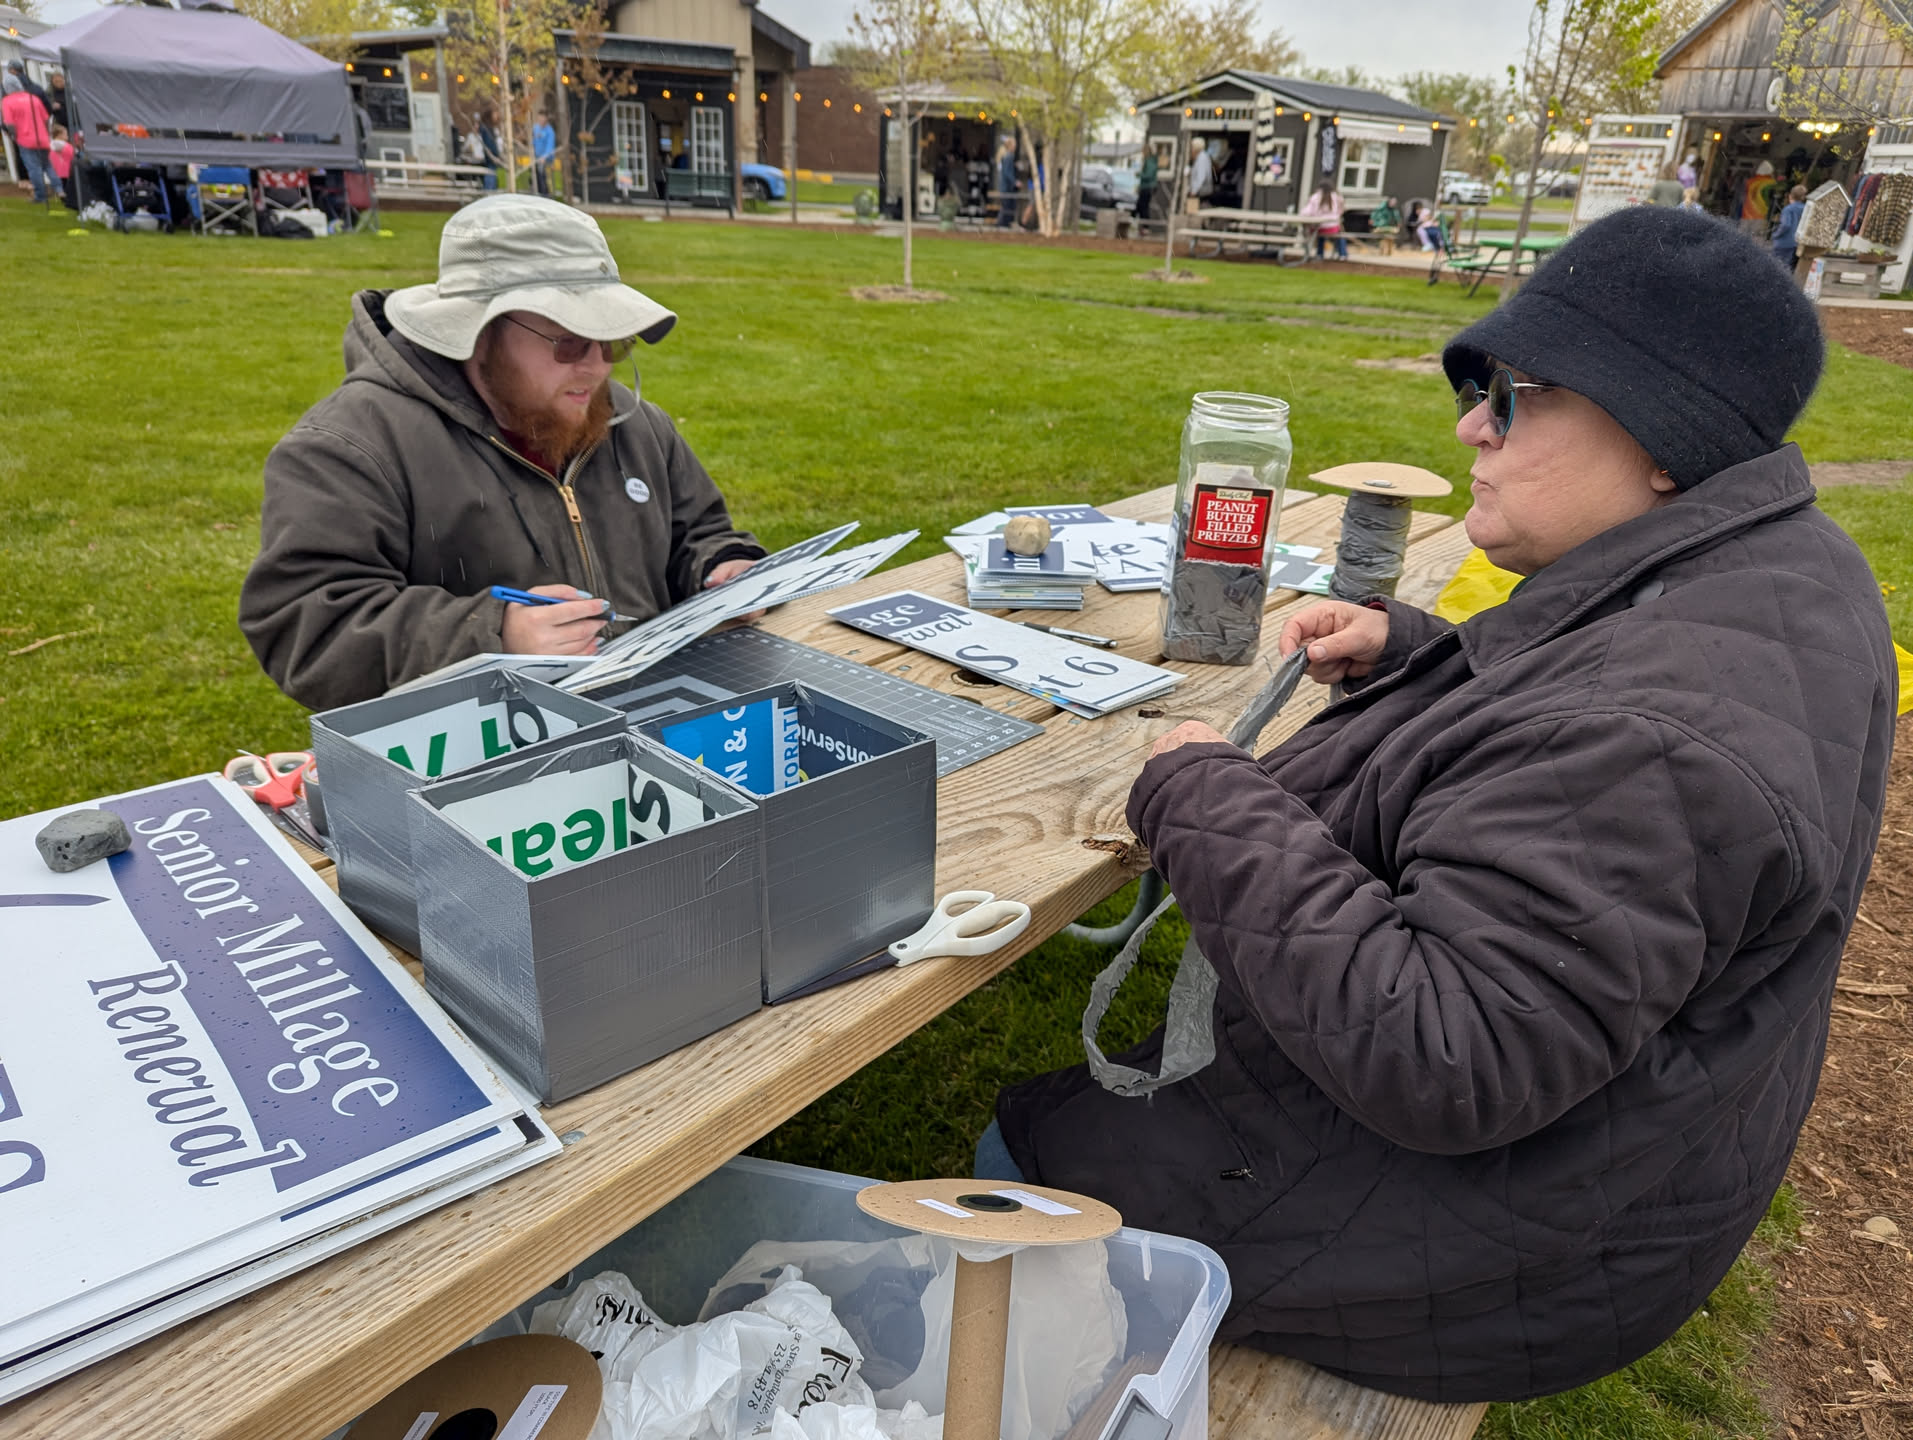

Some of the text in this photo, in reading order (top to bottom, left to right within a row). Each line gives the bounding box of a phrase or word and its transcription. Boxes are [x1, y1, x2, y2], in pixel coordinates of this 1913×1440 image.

[1206, 500, 1259, 513] PEANUT
[1206, 510, 1255, 524] BUTTER
[1197, 530, 1259, 544] PRETZELS
[1206, 521, 1253, 533] FILLED
[850, 605, 923, 628] age
[896, 612, 973, 641] wal
[1065, 656, 1119, 675] 6
[799, 725, 874, 762] onServi
[134, 808, 399, 1116] Senior Millage
[87, 961, 301, 1187] Renewal
